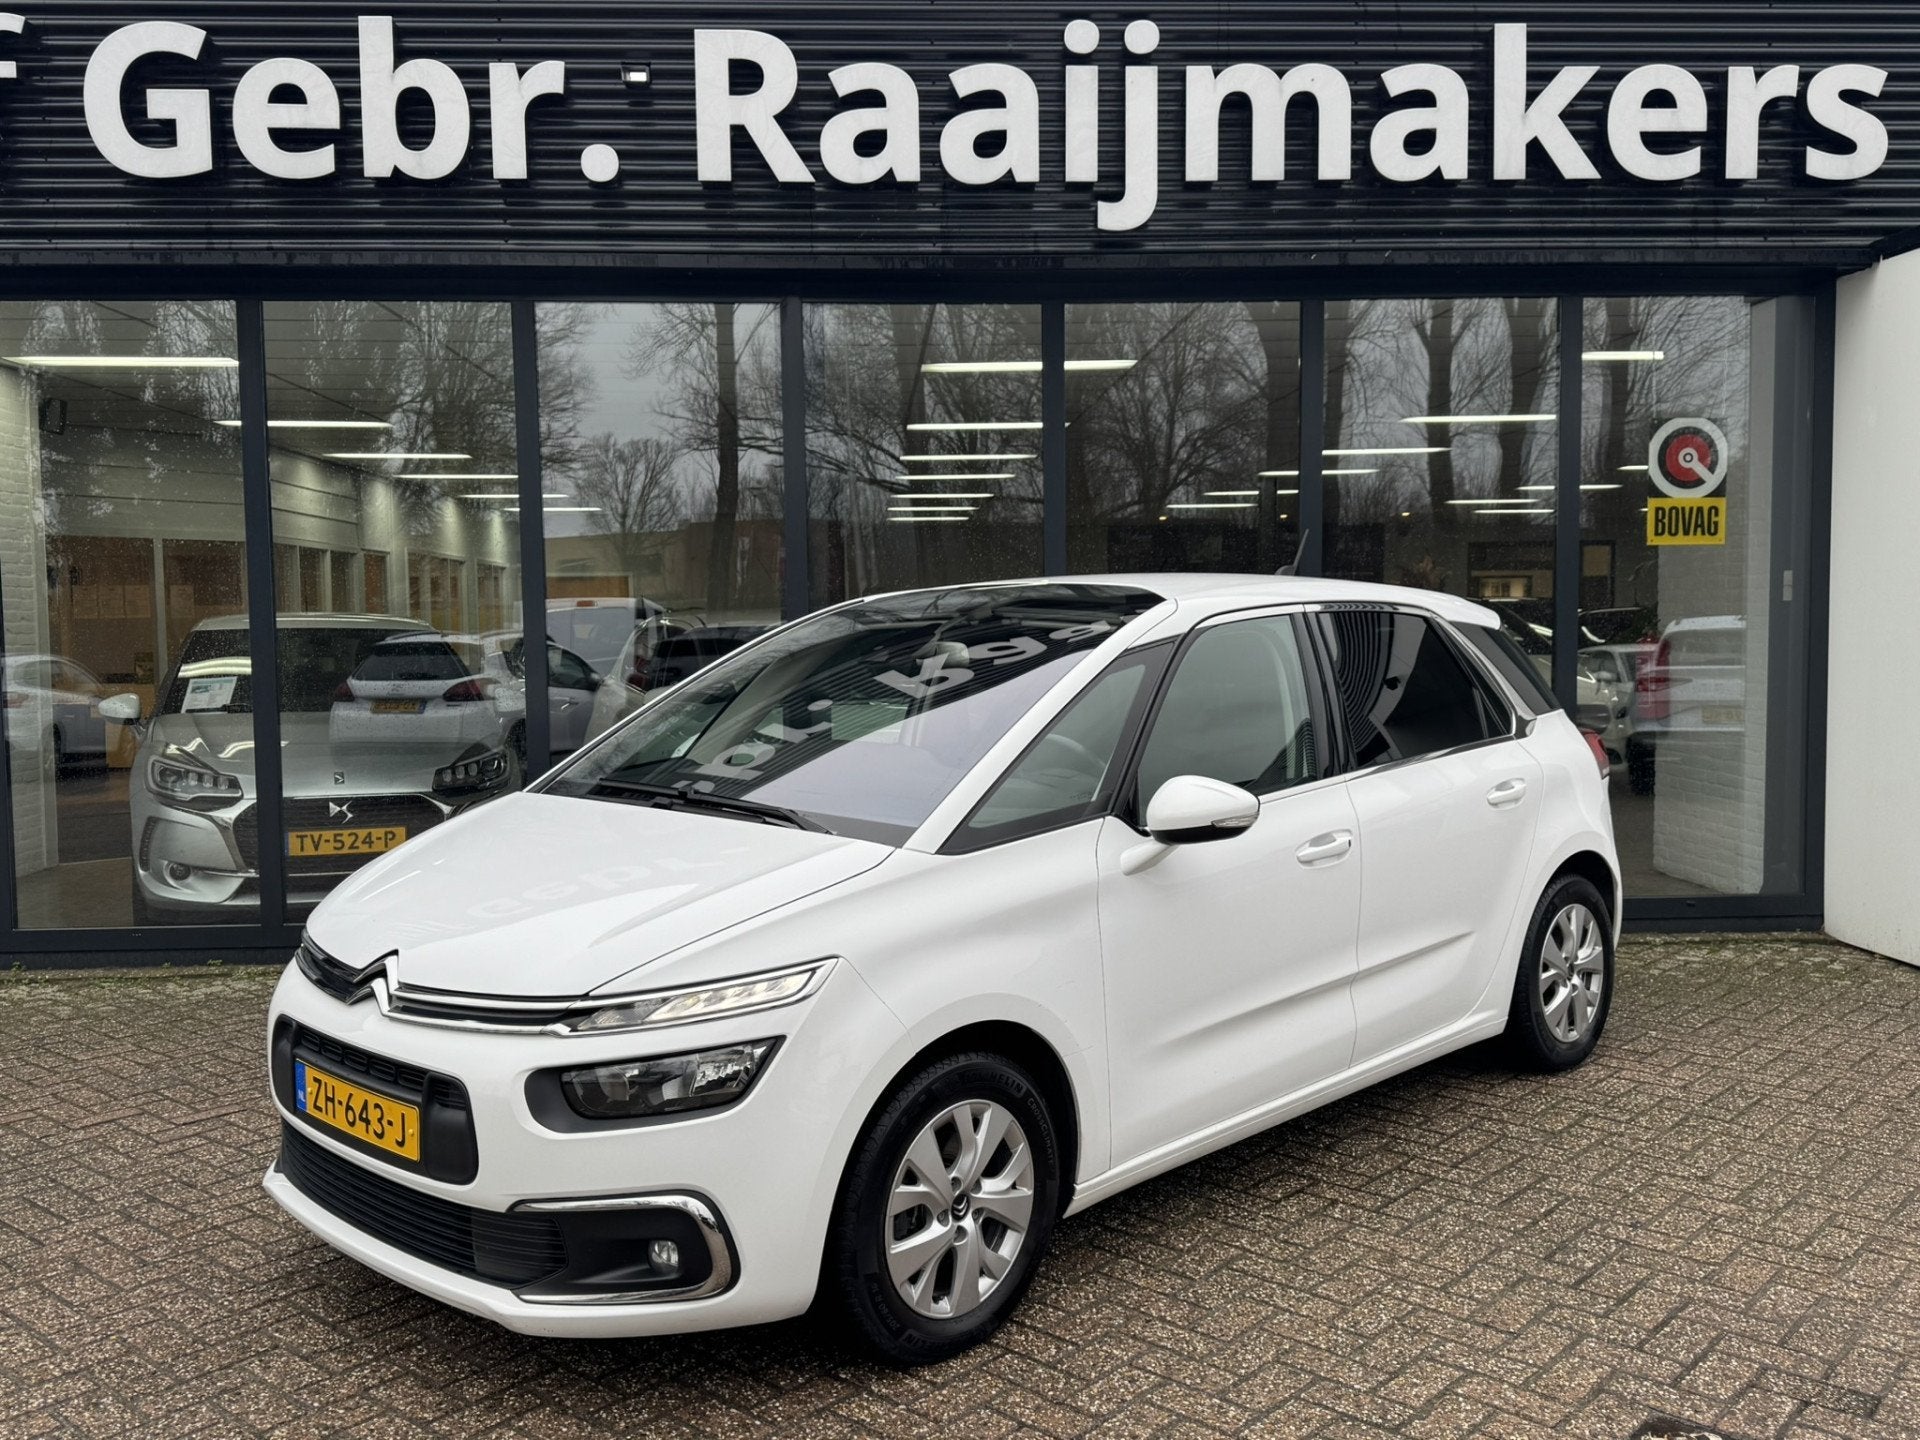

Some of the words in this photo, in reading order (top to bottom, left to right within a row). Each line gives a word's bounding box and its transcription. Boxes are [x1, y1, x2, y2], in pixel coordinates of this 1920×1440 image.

[83, 15, 620, 183] Gebr.
[694, 19, 1889, 231] Raaijmakers
[1654, 505, 1719, 537] BOVAG
[295, 830, 397, 853] TV-524-P
[312, 1075, 406, 1148] ZH-643-J
